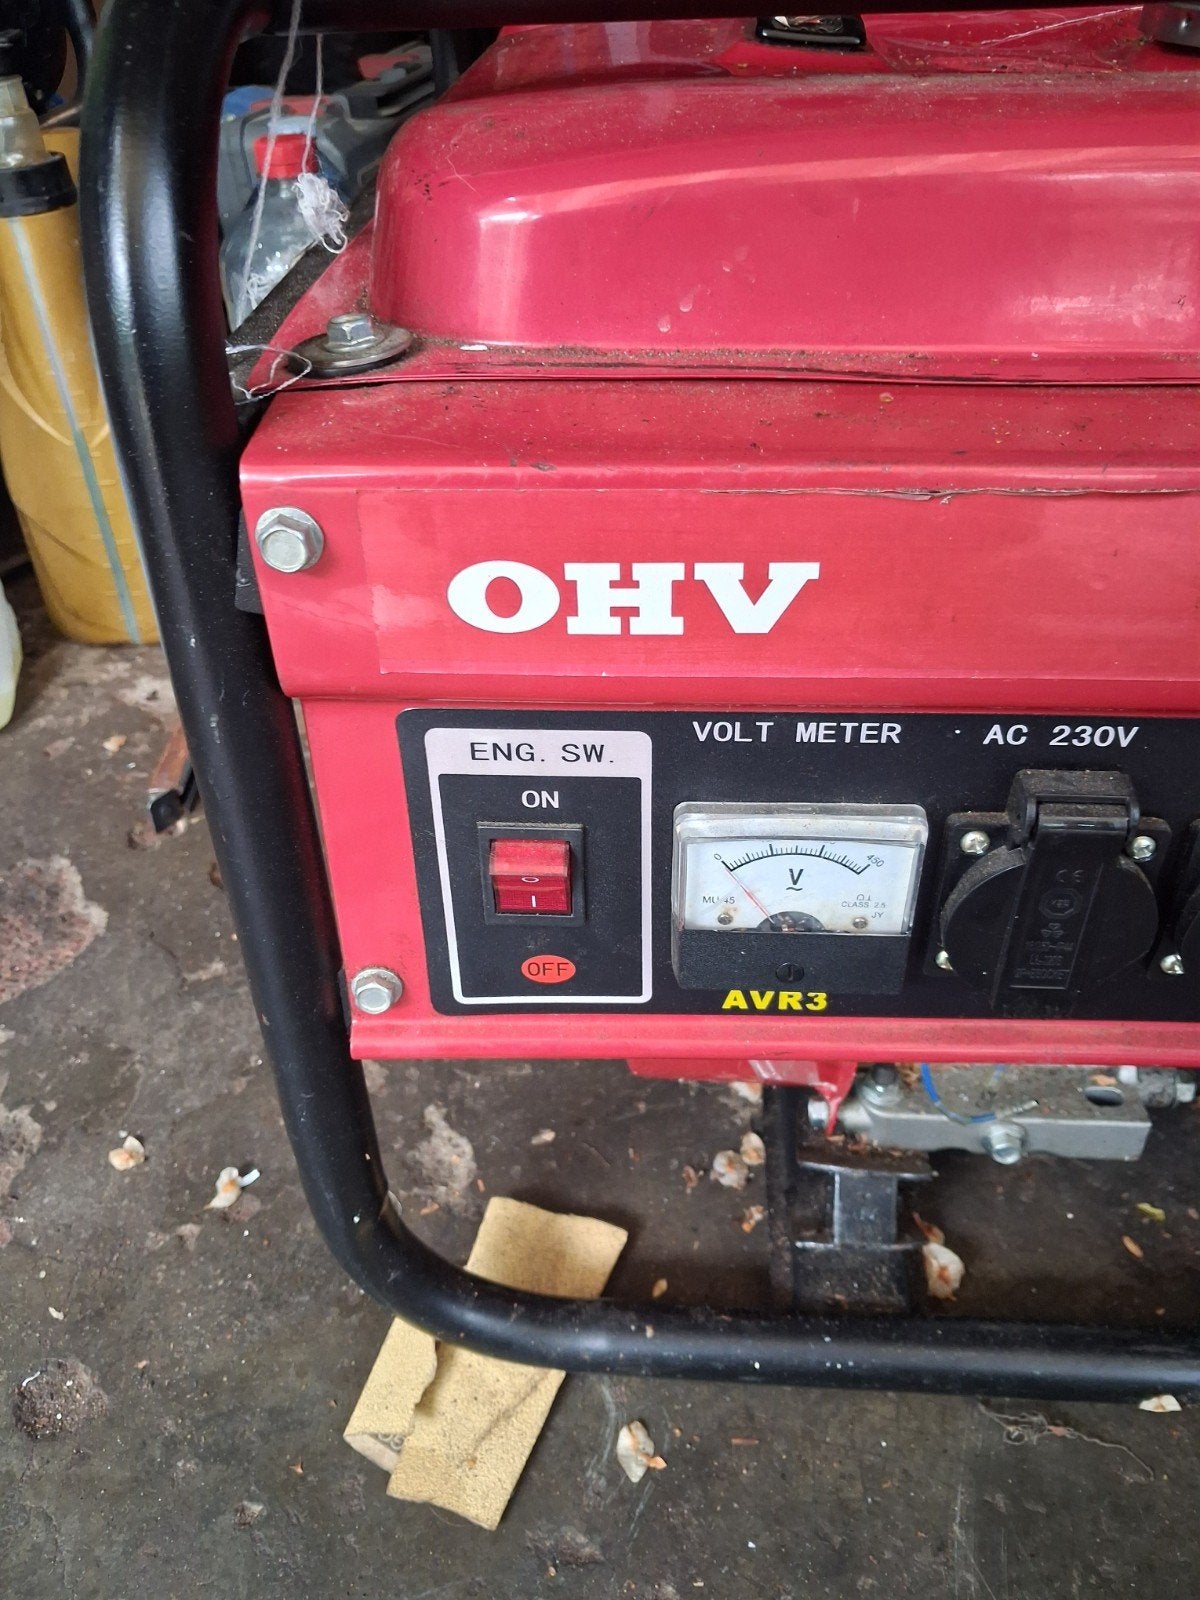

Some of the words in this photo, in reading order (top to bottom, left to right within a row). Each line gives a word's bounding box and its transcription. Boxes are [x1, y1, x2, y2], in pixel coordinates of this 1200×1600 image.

[447, 560, 820, 635] OHV
[692, 721, 774, 742] VOLT
[795, 722, 902, 744] METER
[983, 724, 1028, 745] AC
[1049, 724, 1139, 747] 230V
[470, 741, 545, 763] ENG.
[561, 743, 615, 763] SW.
[521, 789, 559, 808] ON
[866, 853, 885, 868] 450
[527, 961, 568, 977] OFF
[721, 989, 828, 1011] AVR3
